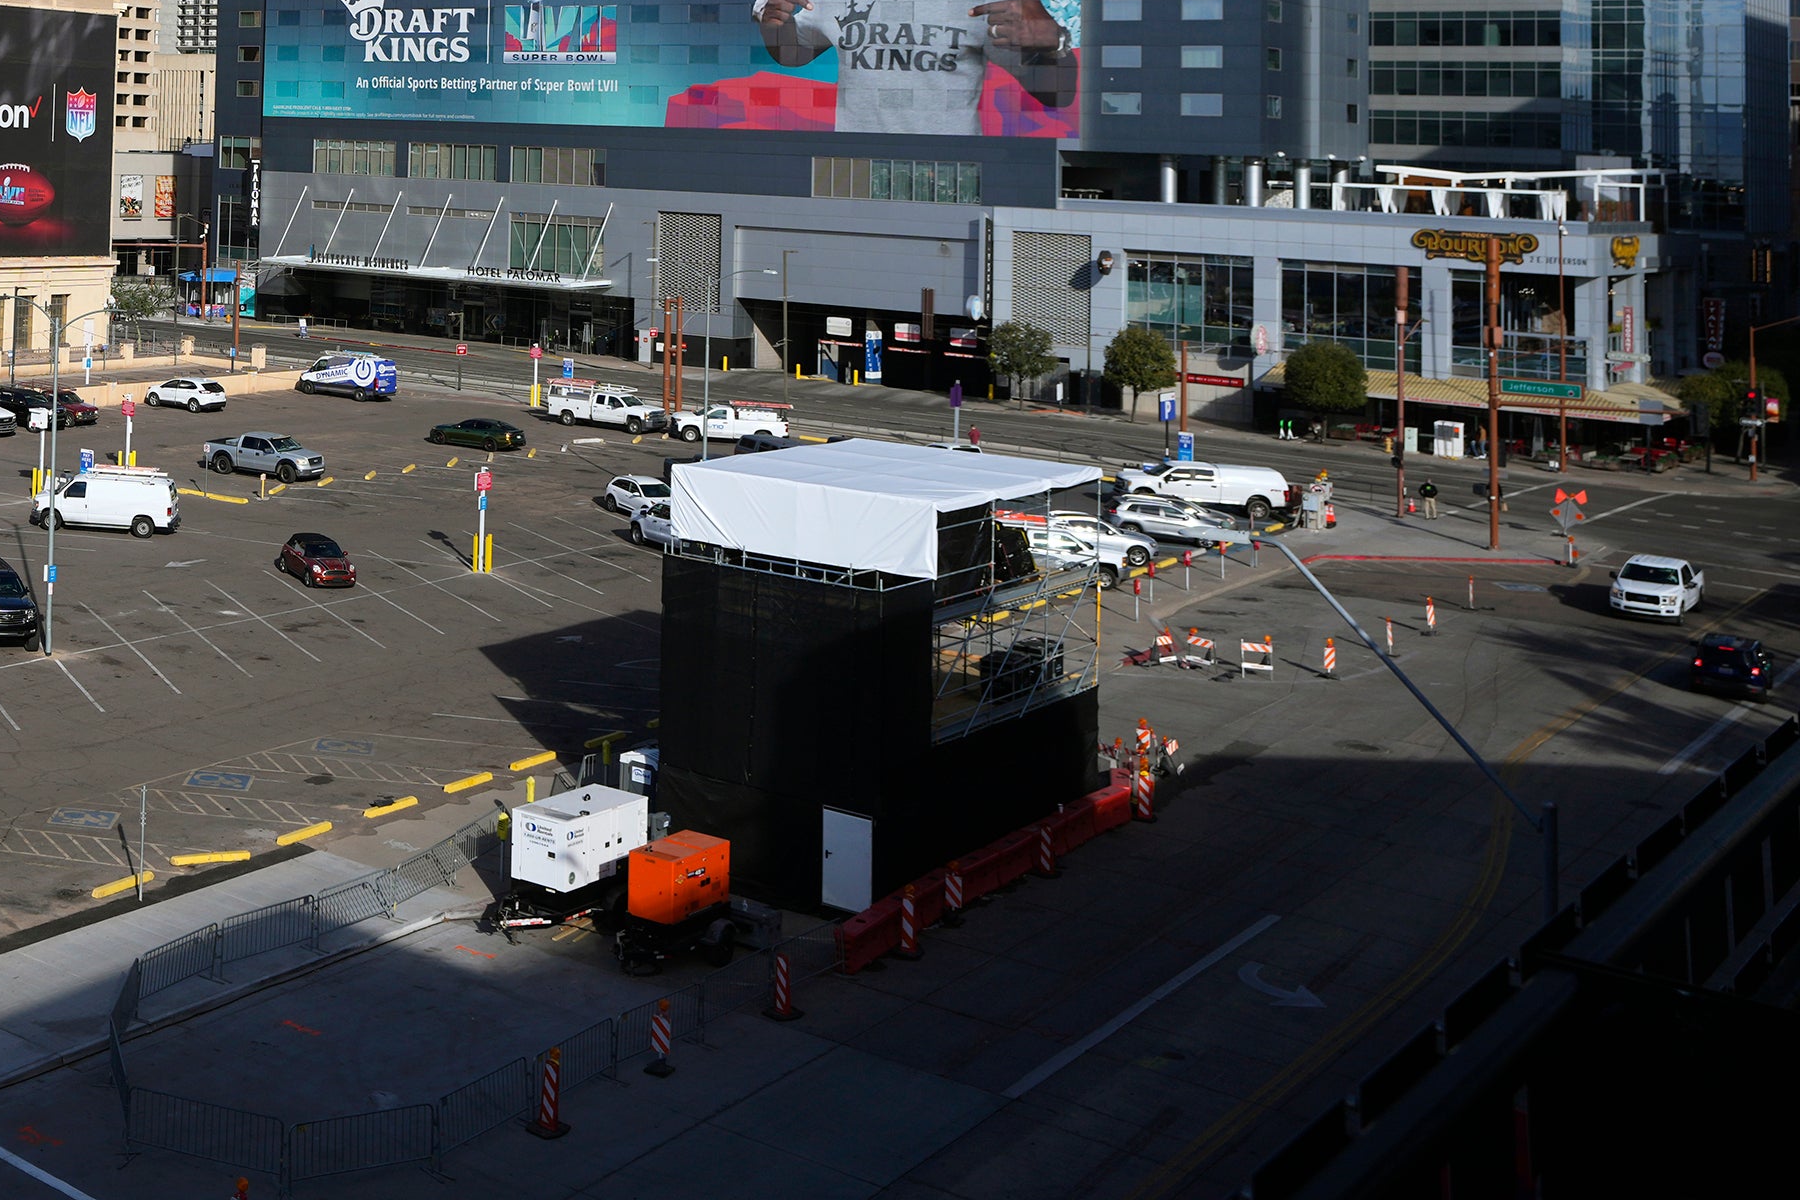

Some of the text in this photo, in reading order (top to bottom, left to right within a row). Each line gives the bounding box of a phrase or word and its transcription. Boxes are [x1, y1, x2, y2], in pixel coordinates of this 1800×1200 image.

[350, 7, 475, 41] DRAFT
[504, 5, 617, 52] LVII
[838, 22, 967, 50] DRAFT
[363, 34, 470, 62] KINGS
[512, 53, 607, 62] SUPER BOWL
[851, 46, 957, 72] KINGS
[356, 76, 618, 94] An Official Sports Betting Partner of Super Bowl LVII
[70, 110, 93, 131] NFL
[250, 164, 259, 226] PALOMAR
[316, 252, 409, 270] CITYSCAPE RESIDENCES
[467, 266, 561, 283] HOTEL PALOMAR
[315, 368, 348, 380] DYNAMIC
[1508, 383, 1554, 394] Jefferson
